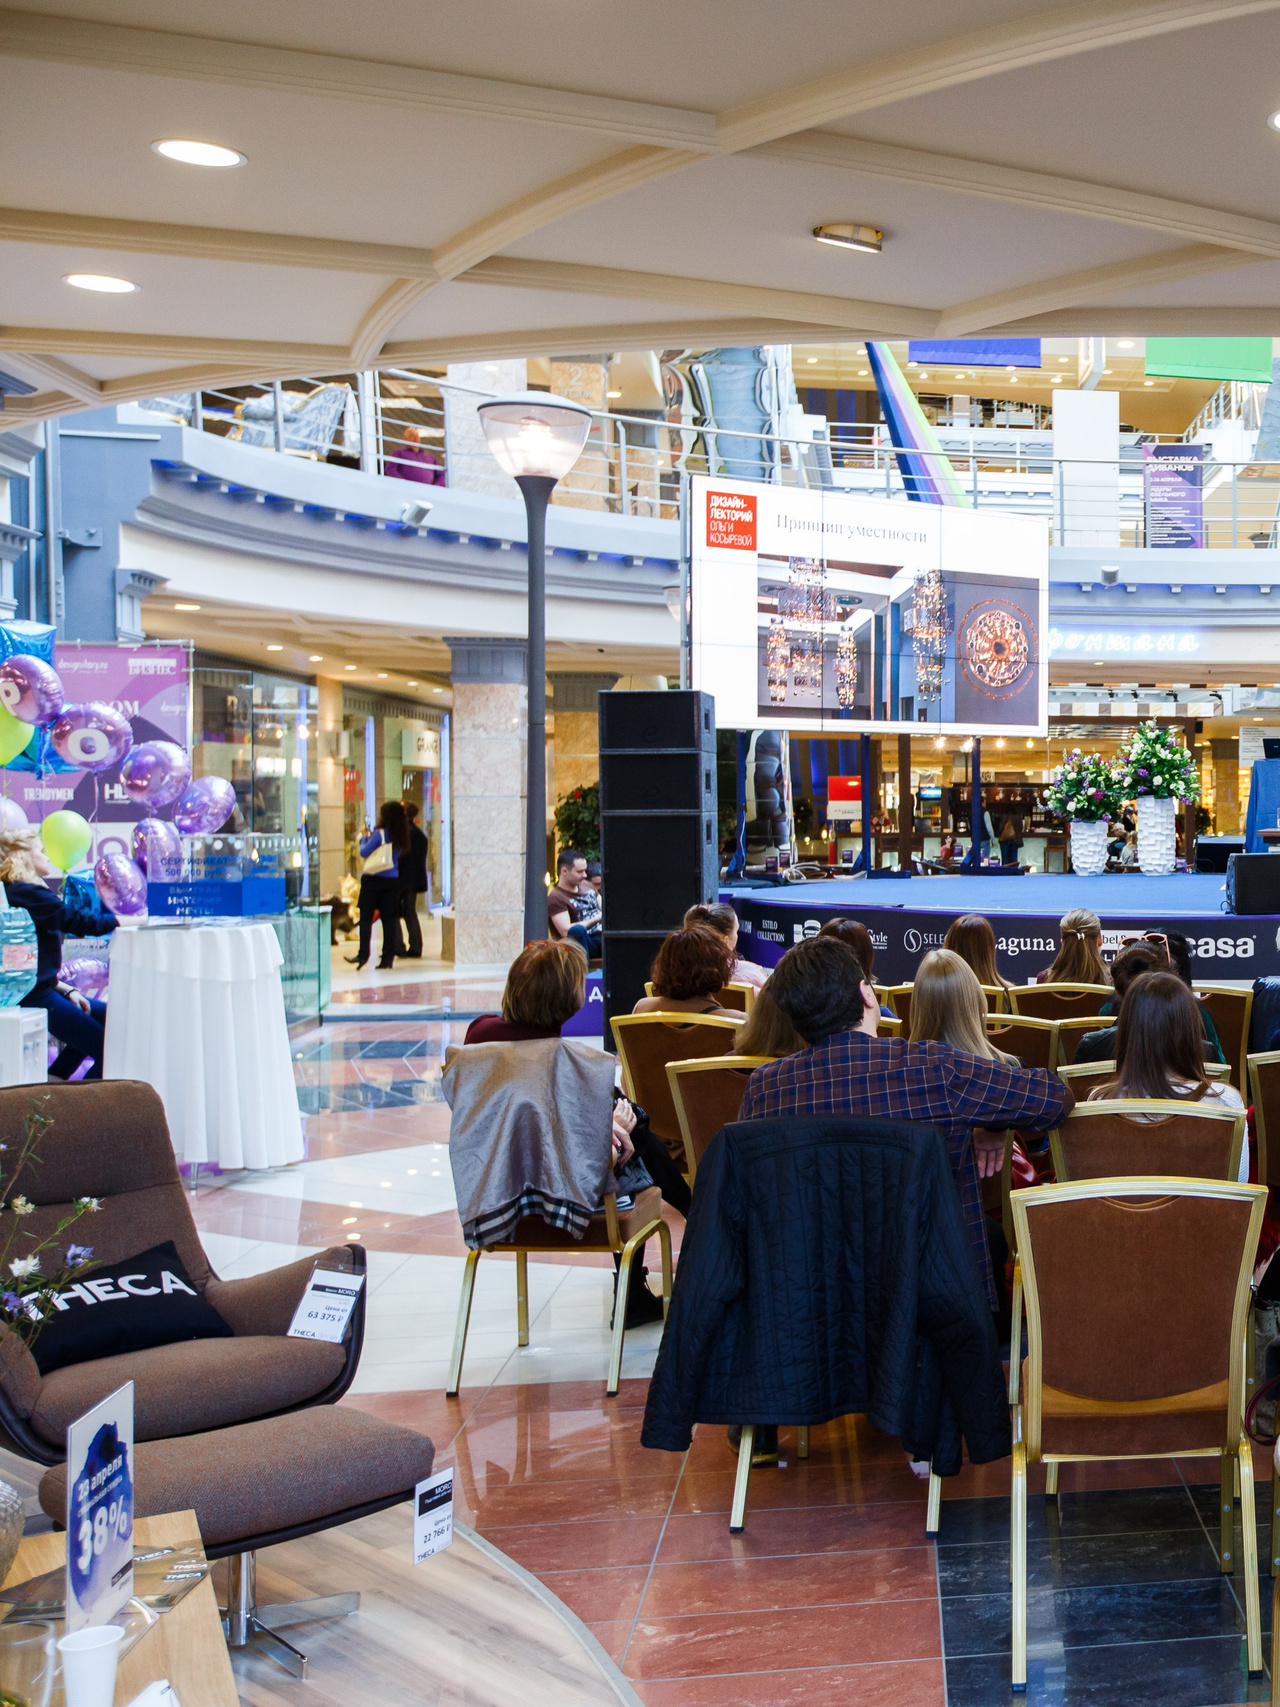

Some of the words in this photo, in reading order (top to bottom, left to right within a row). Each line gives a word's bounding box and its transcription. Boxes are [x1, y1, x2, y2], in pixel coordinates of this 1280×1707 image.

[710, 508, 753, 522] ЛЕКТОРИЙ
[710, 520, 734, 533] ОЛЬГИ
[777, 514, 843, 534] Принцип
[848, 526, 928, 543] уместности
[710, 532, 752, 546] КОСЫРЕВОЙ
[762, 919, 778, 930] ESTILO
[757, 931, 785, 943] COLLECTION
[995, 937, 1056, 956] aguna
[308, 1311, 319, 1319] 63
[320, 1313, 336, 1322] 375
[293, 1328, 316, 1338] THECA
[78, 1478, 90, 1503] 23
[91, 1454, 123, 1490] апреля
[78, 1494, 128, 1570] 38%
[423, 1533, 432, 1544] 22
[433, 1526, 446, 1539] 766
[417, 1548, 436, 1561] THECA
